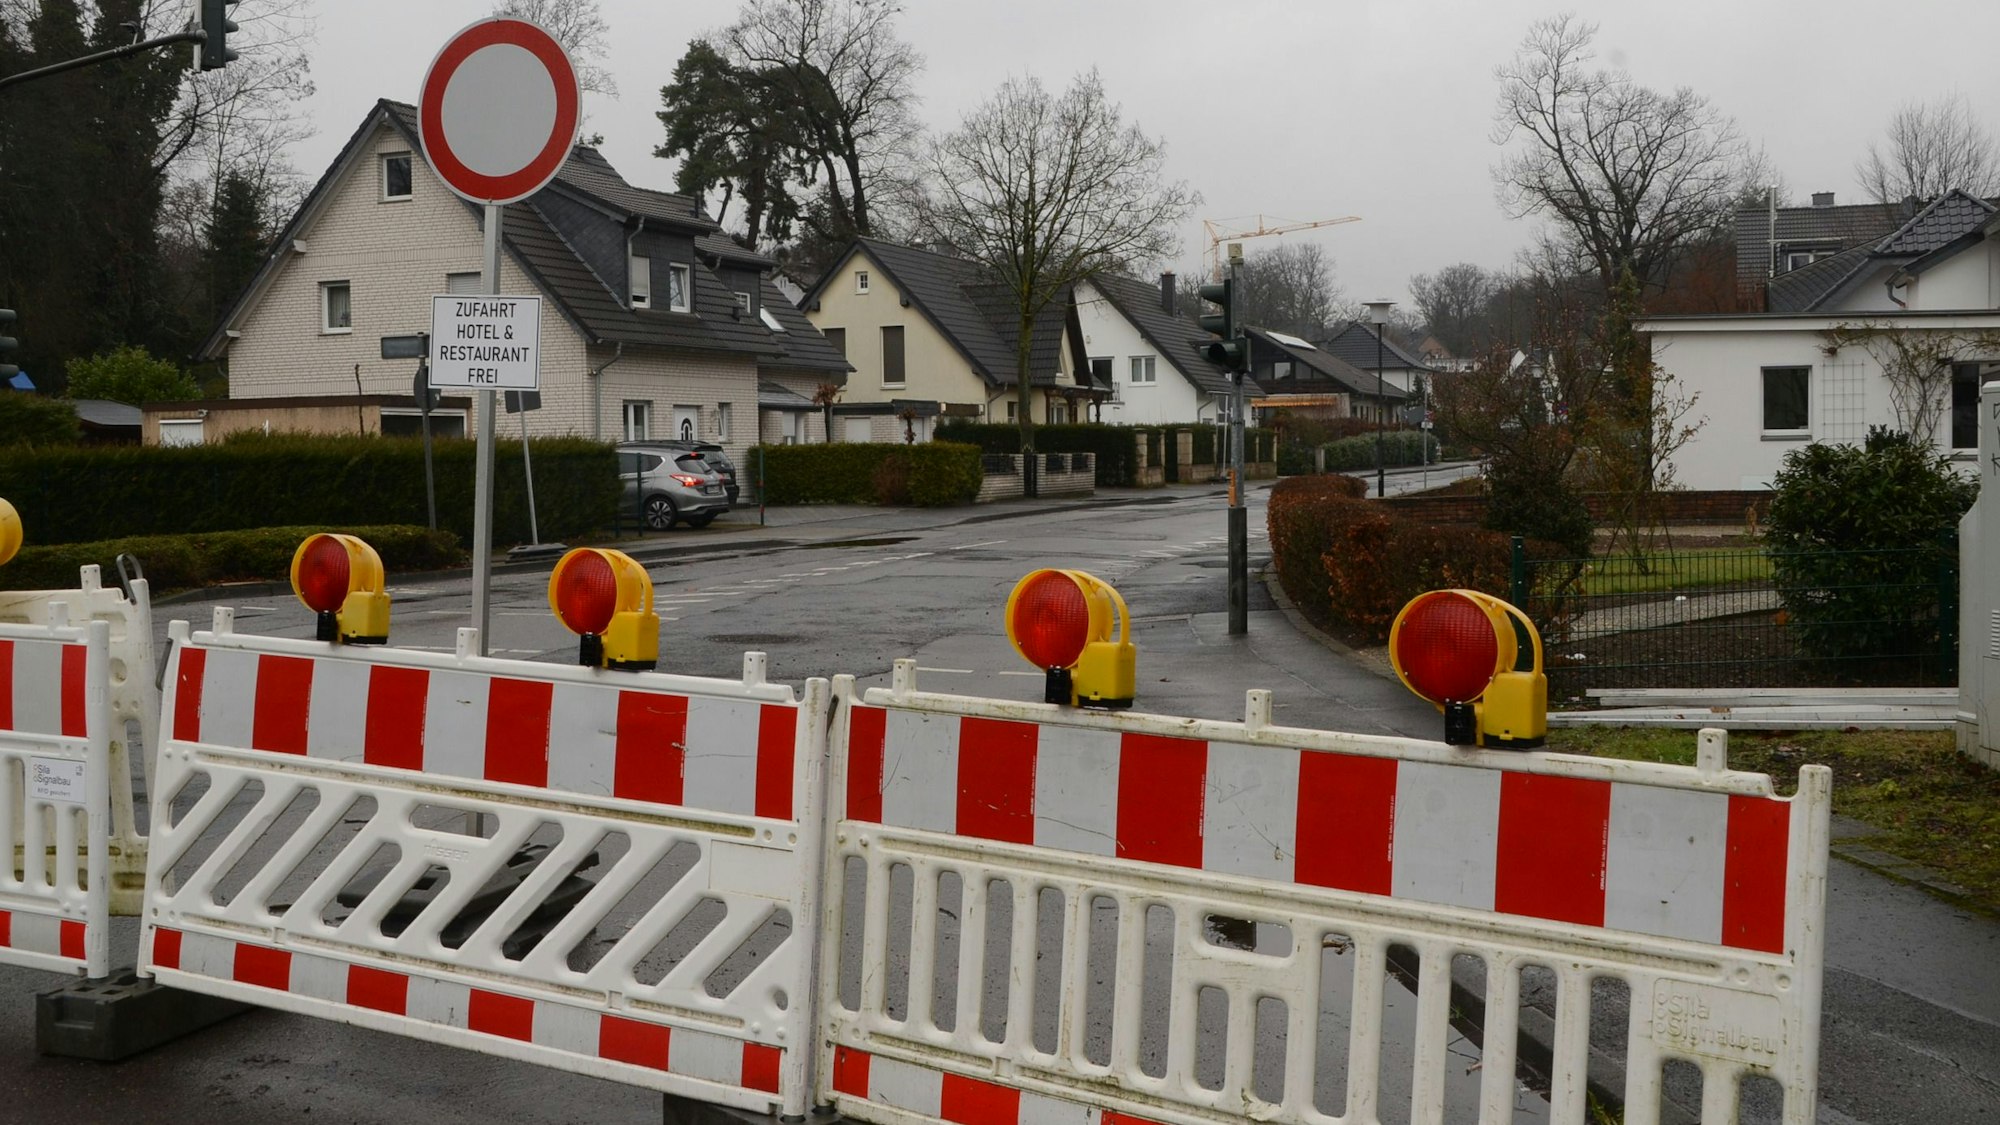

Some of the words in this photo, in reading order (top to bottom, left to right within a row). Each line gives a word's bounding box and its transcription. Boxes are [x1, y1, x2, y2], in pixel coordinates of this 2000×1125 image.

[456, 302, 516, 318] ZUFAHRT
[457, 324, 500, 339] HOTEL
[504, 325, 513, 339] &
[440, 345, 529, 362] RESTAURANT
[468, 368, 498, 383] FREI
[37, 774, 71, 786] Signalbau
[1668, 994, 1710, 1020] Sila
[1667, 1016, 1777, 1055] Signalbau
